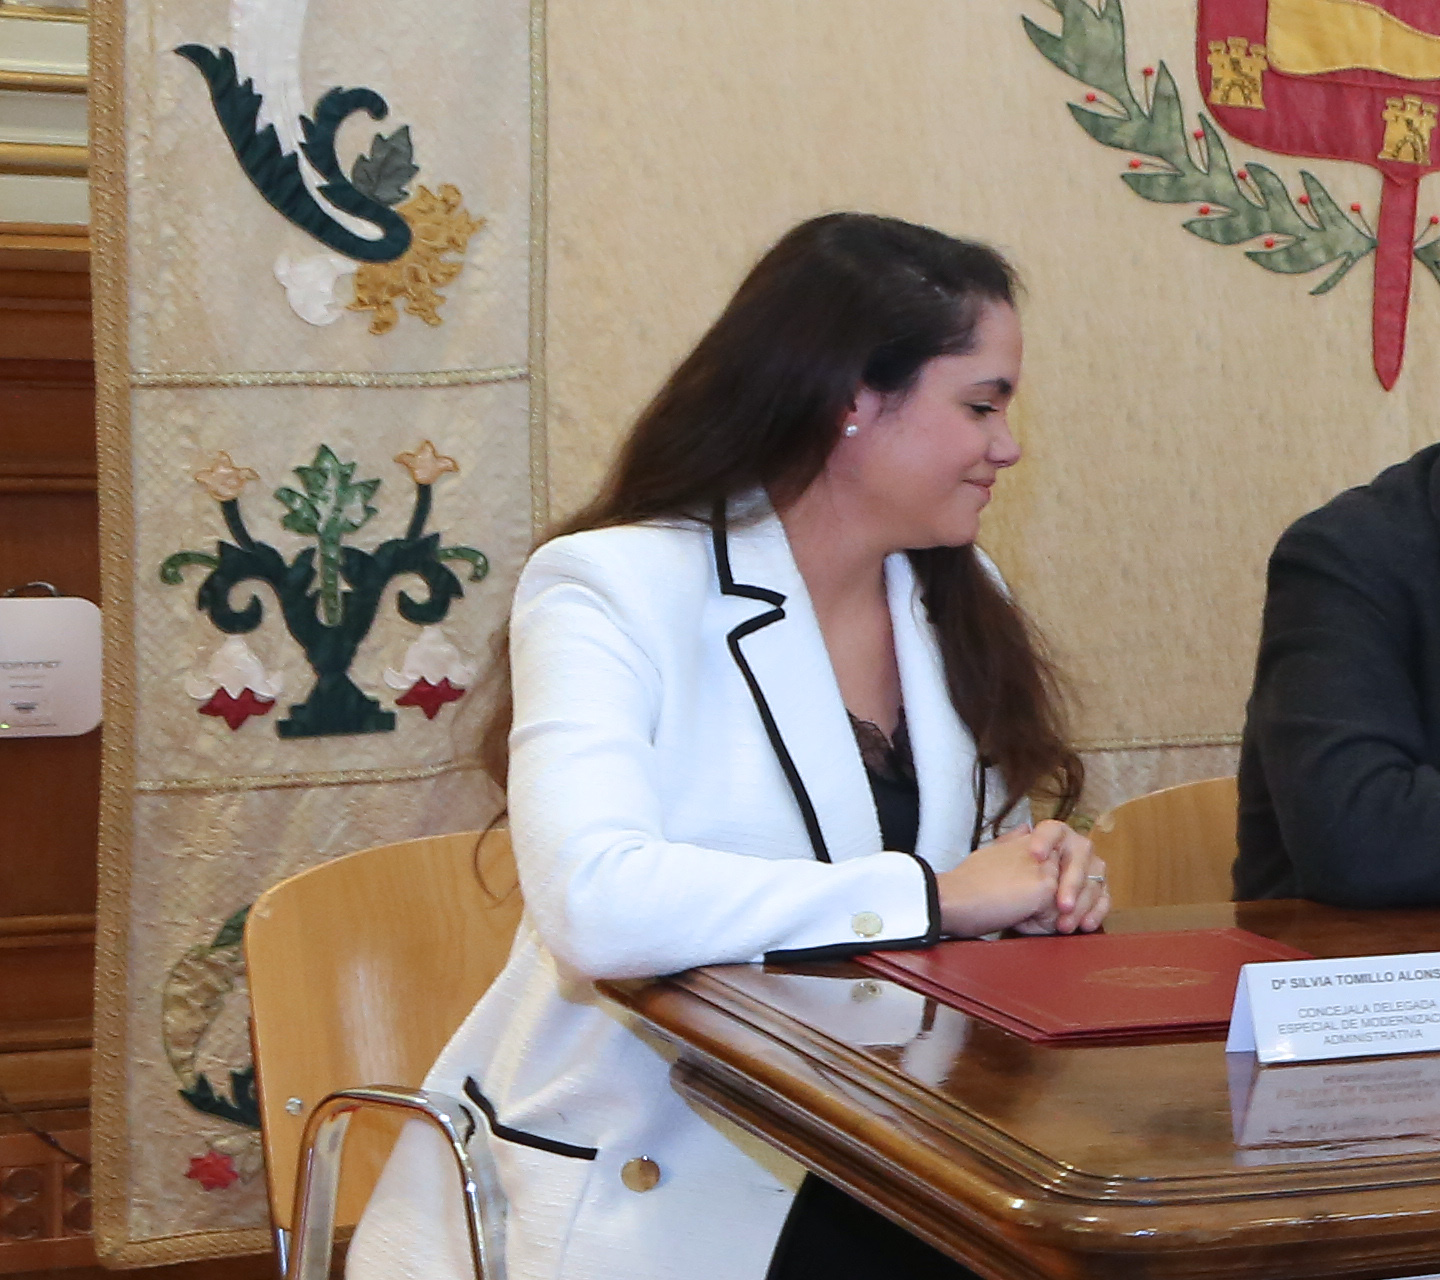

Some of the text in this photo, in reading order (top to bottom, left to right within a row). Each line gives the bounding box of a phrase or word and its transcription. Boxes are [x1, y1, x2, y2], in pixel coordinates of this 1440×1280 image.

[1271, 977, 1287, 990] Dª
[1289, 974, 1333, 989] SILVIA
[1337, 970, 1395, 986] TOMILLO
[1297, 998, 1438, 1019] CONCEJALA DELEGADA
[1278, 1021, 1338, 1036] ESPECIAL
[1341, 1018, 1357, 1031] DE
[1322, 1028, 1424, 1046] ADMINISTRATIVA
